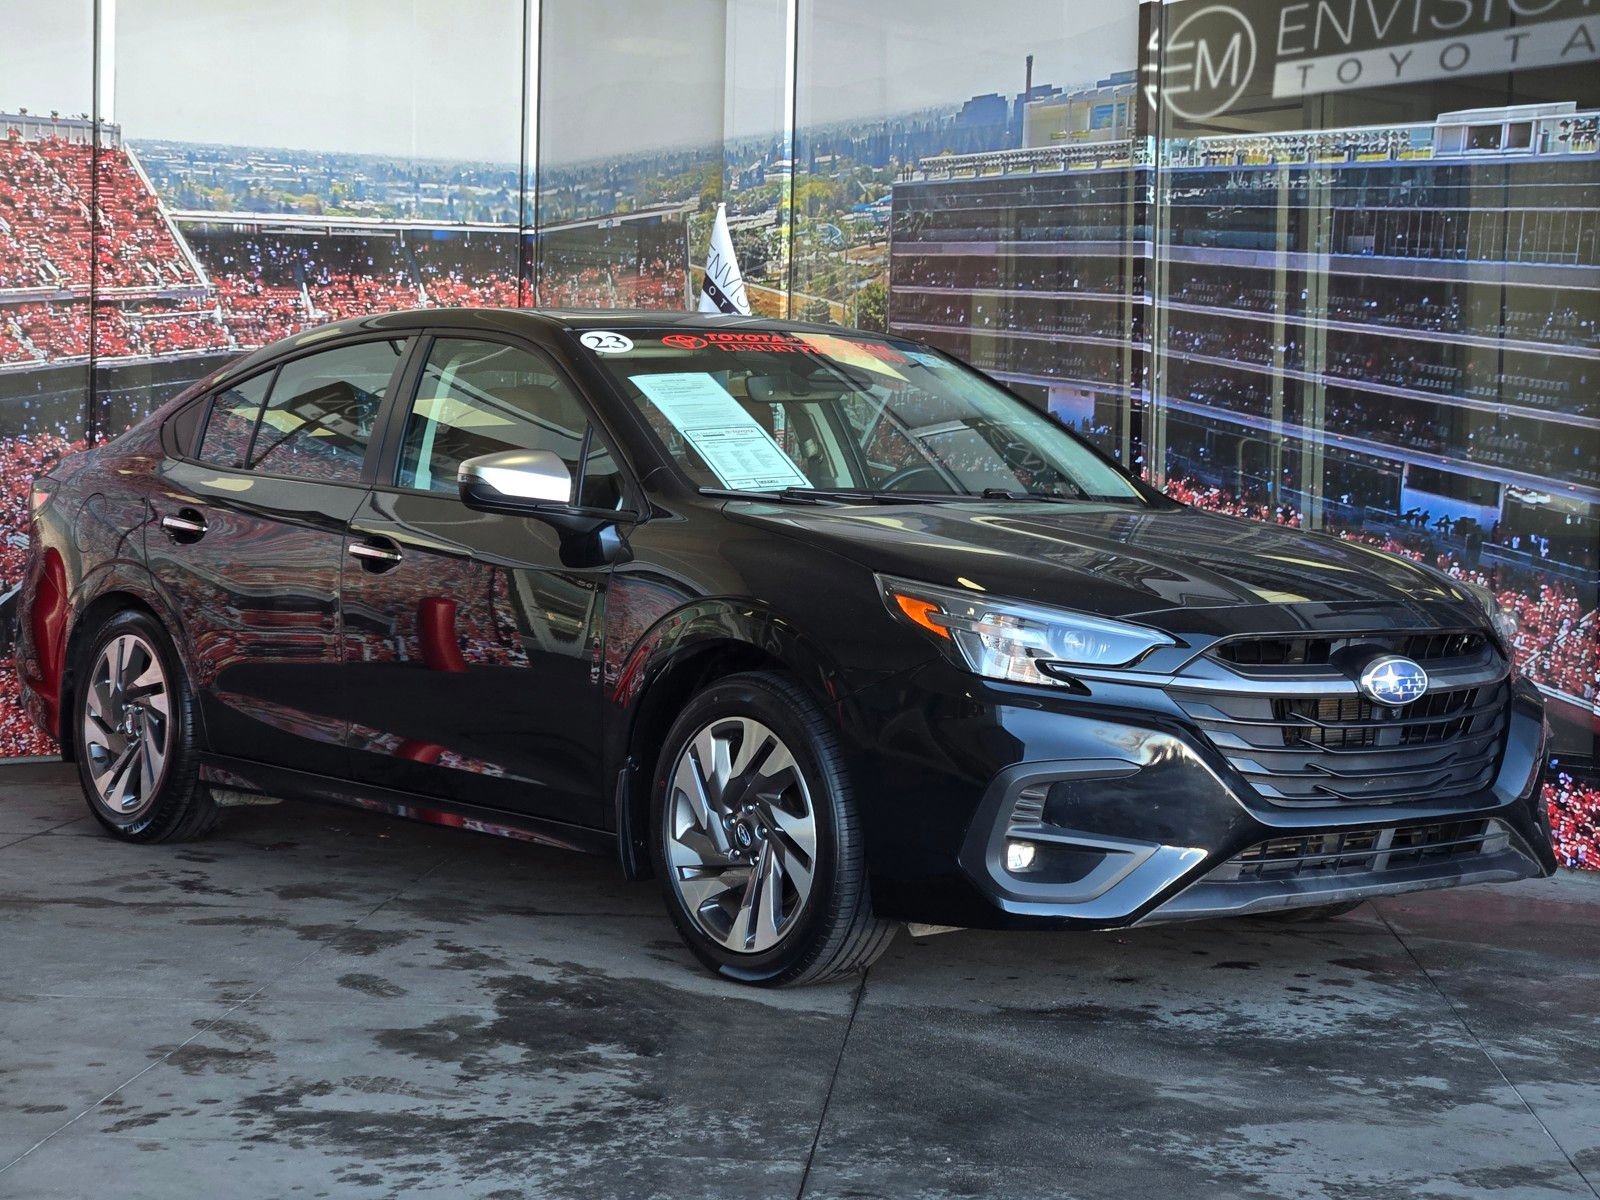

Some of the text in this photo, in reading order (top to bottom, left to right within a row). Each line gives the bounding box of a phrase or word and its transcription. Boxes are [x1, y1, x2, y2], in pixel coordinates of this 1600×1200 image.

[1276, 0, 1592, 55] ENVIS
[1297, 23, 1597, 89] TOYOTA
[586, 335, 628, 349] 23
[704, 333, 785, 343] TOYOTA
[717, 344, 797, 353] LUXURY
